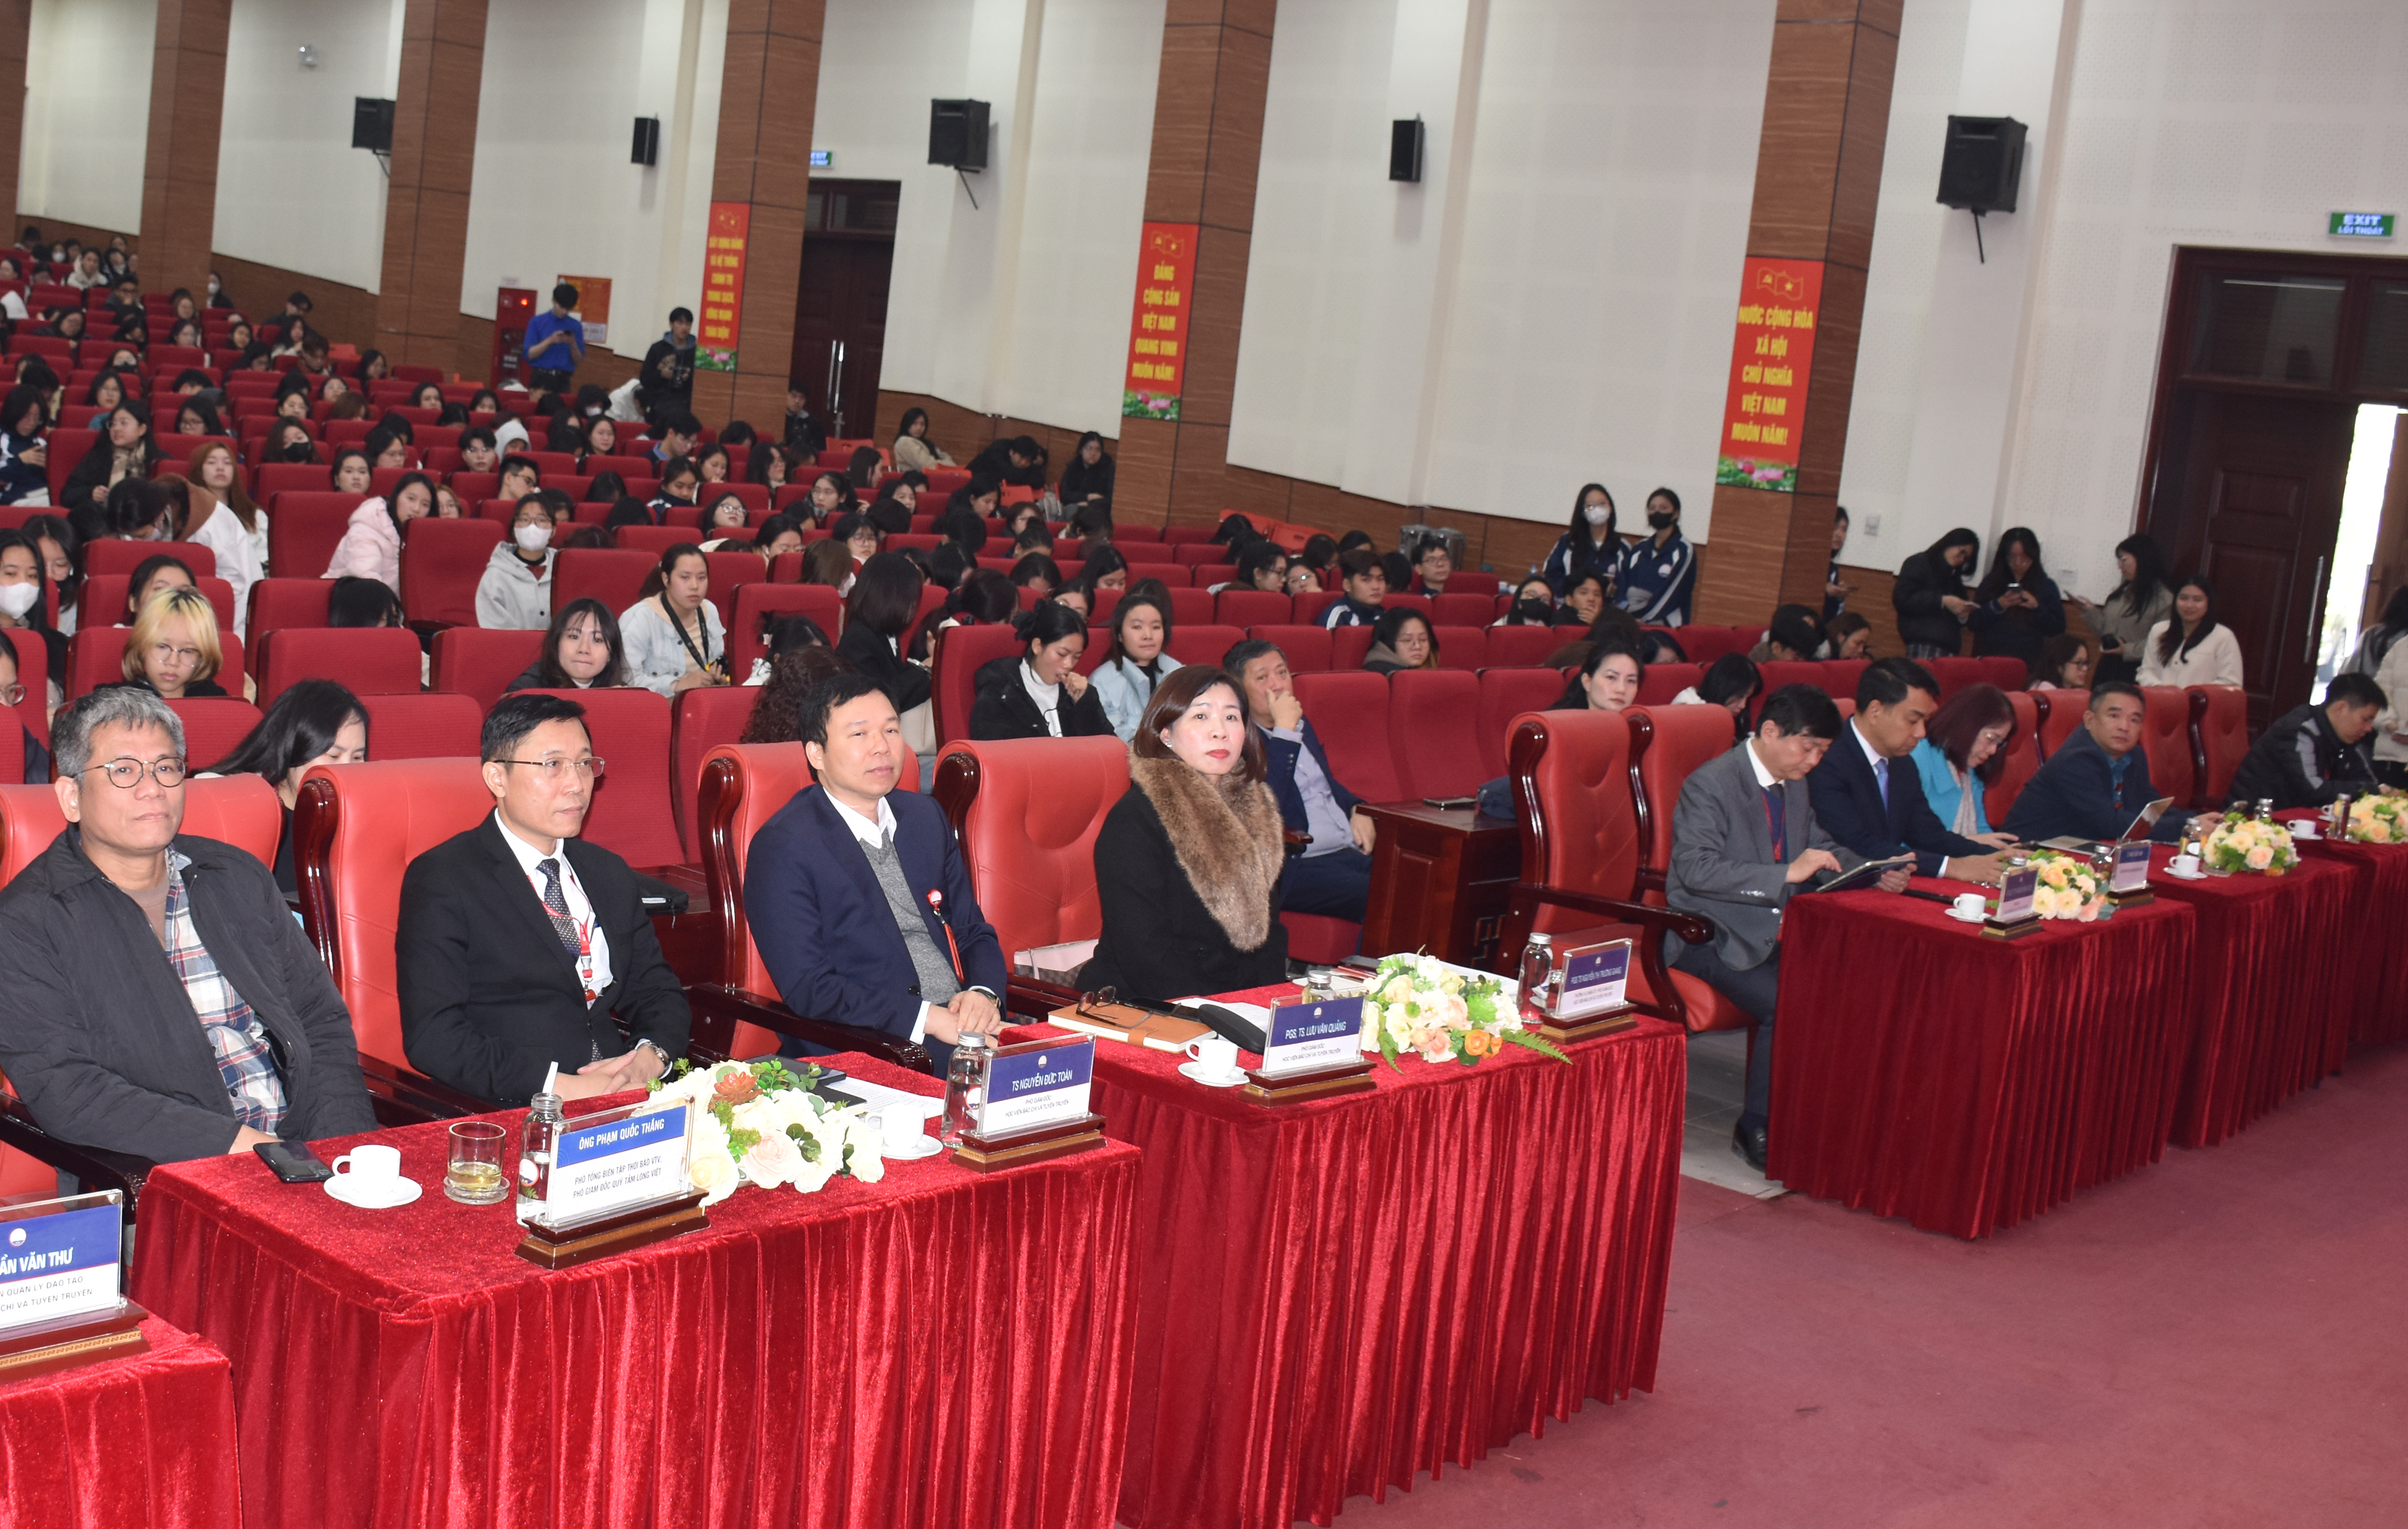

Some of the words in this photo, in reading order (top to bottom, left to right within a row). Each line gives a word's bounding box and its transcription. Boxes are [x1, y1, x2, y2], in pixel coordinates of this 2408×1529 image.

[2343, 213, 2383, 226] EXIT
[1765, 305, 1792, 330] CỘNG
[1742, 392, 1762, 416] VIỆT
[1763, 397, 1787, 416] NAM
[1731, 420, 1761, 442] MUÔN
[1012, 1080, 1019, 1091] TS
[1019, 1072, 1043, 1090] NGUYỄN
[1044, 1072, 1057, 1085] ĐỨC
[579, 1136, 594, 1150] ÔNG
[596, 1130, 618, 1145] PHẠM
[620, 1123, 639, 1140] QUỐC
[19, 1251, 46, 1272] VĂN
[48, 1246, 73, 1267] THƯ
